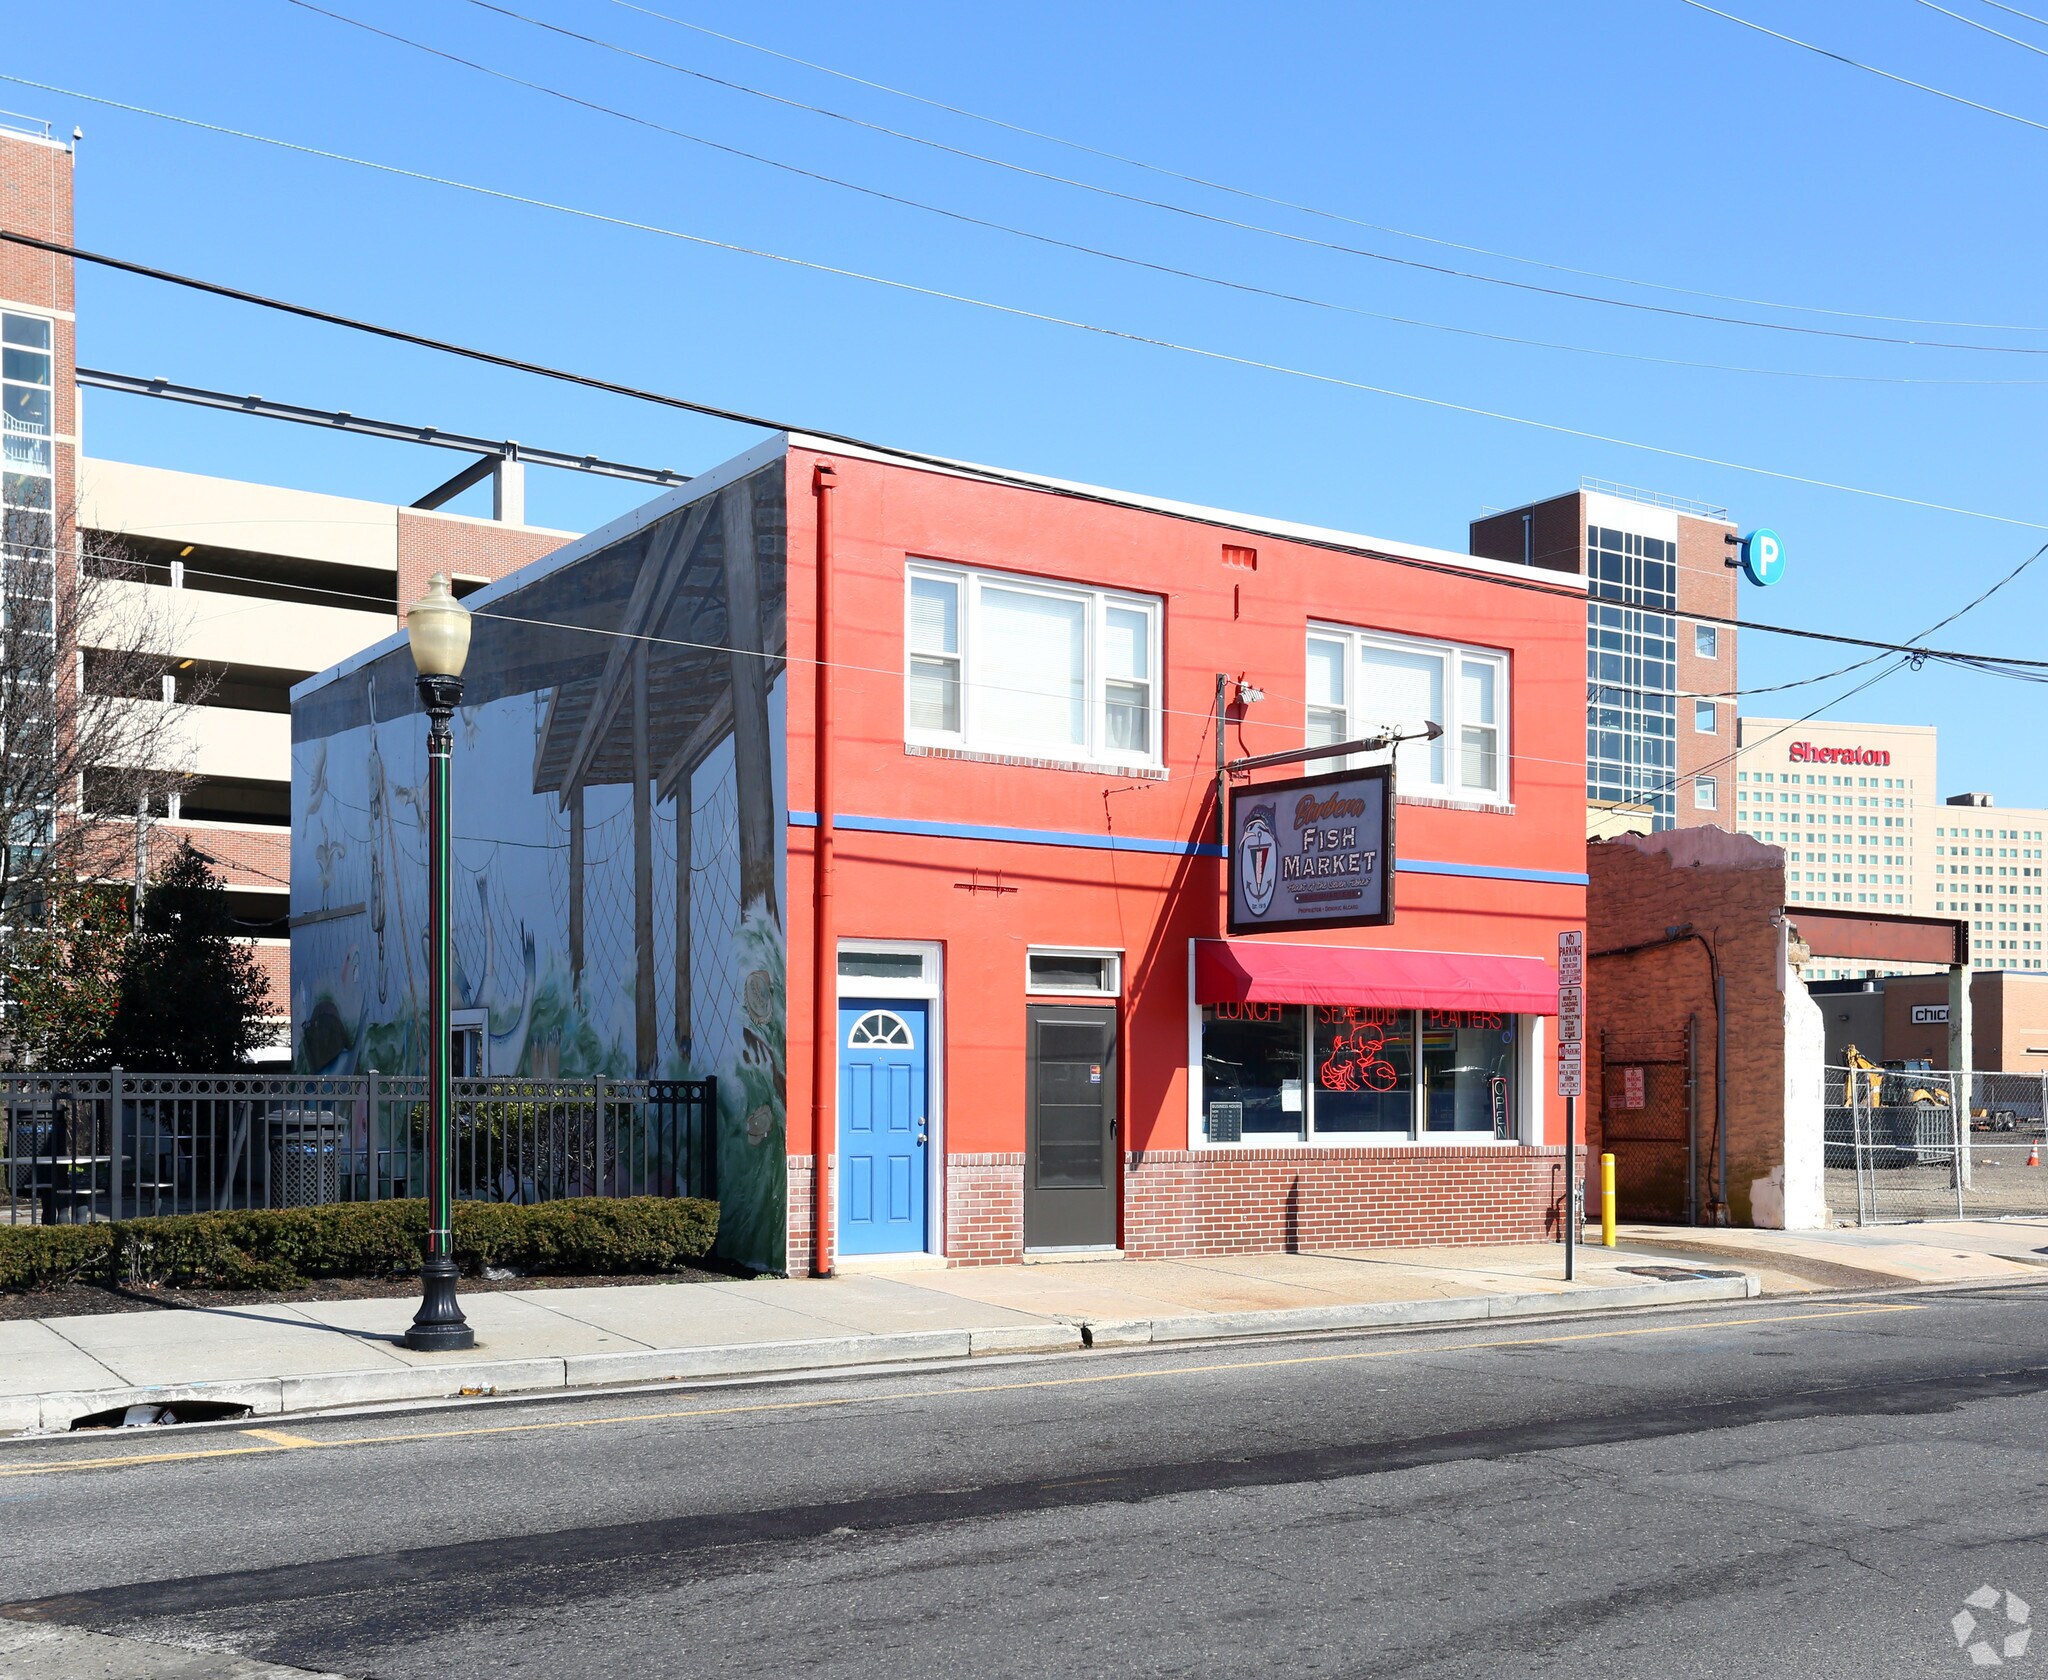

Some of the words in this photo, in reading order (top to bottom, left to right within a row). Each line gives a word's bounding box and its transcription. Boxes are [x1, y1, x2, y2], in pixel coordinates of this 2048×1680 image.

[1760, 535, 1778, 576] P
[1789, 741, 1890, 766] Sheraton
[1294, 791, 1366, 830] Barbera
[1302, 826, 1356, 854] FISH
[1282, 850, 1377, 882] MARKET
[1560, 946, 1581, 956] PARKING
[1566, 935, 1574, 945] NO
[1216, 1002, 1282, 1022] LUNCH
[1431, 1010, 1502, 1030] PLATTERS
[1916, 1007, 1949, 1021] chic
[1494, 1080, 1507, 1140] OPEN
